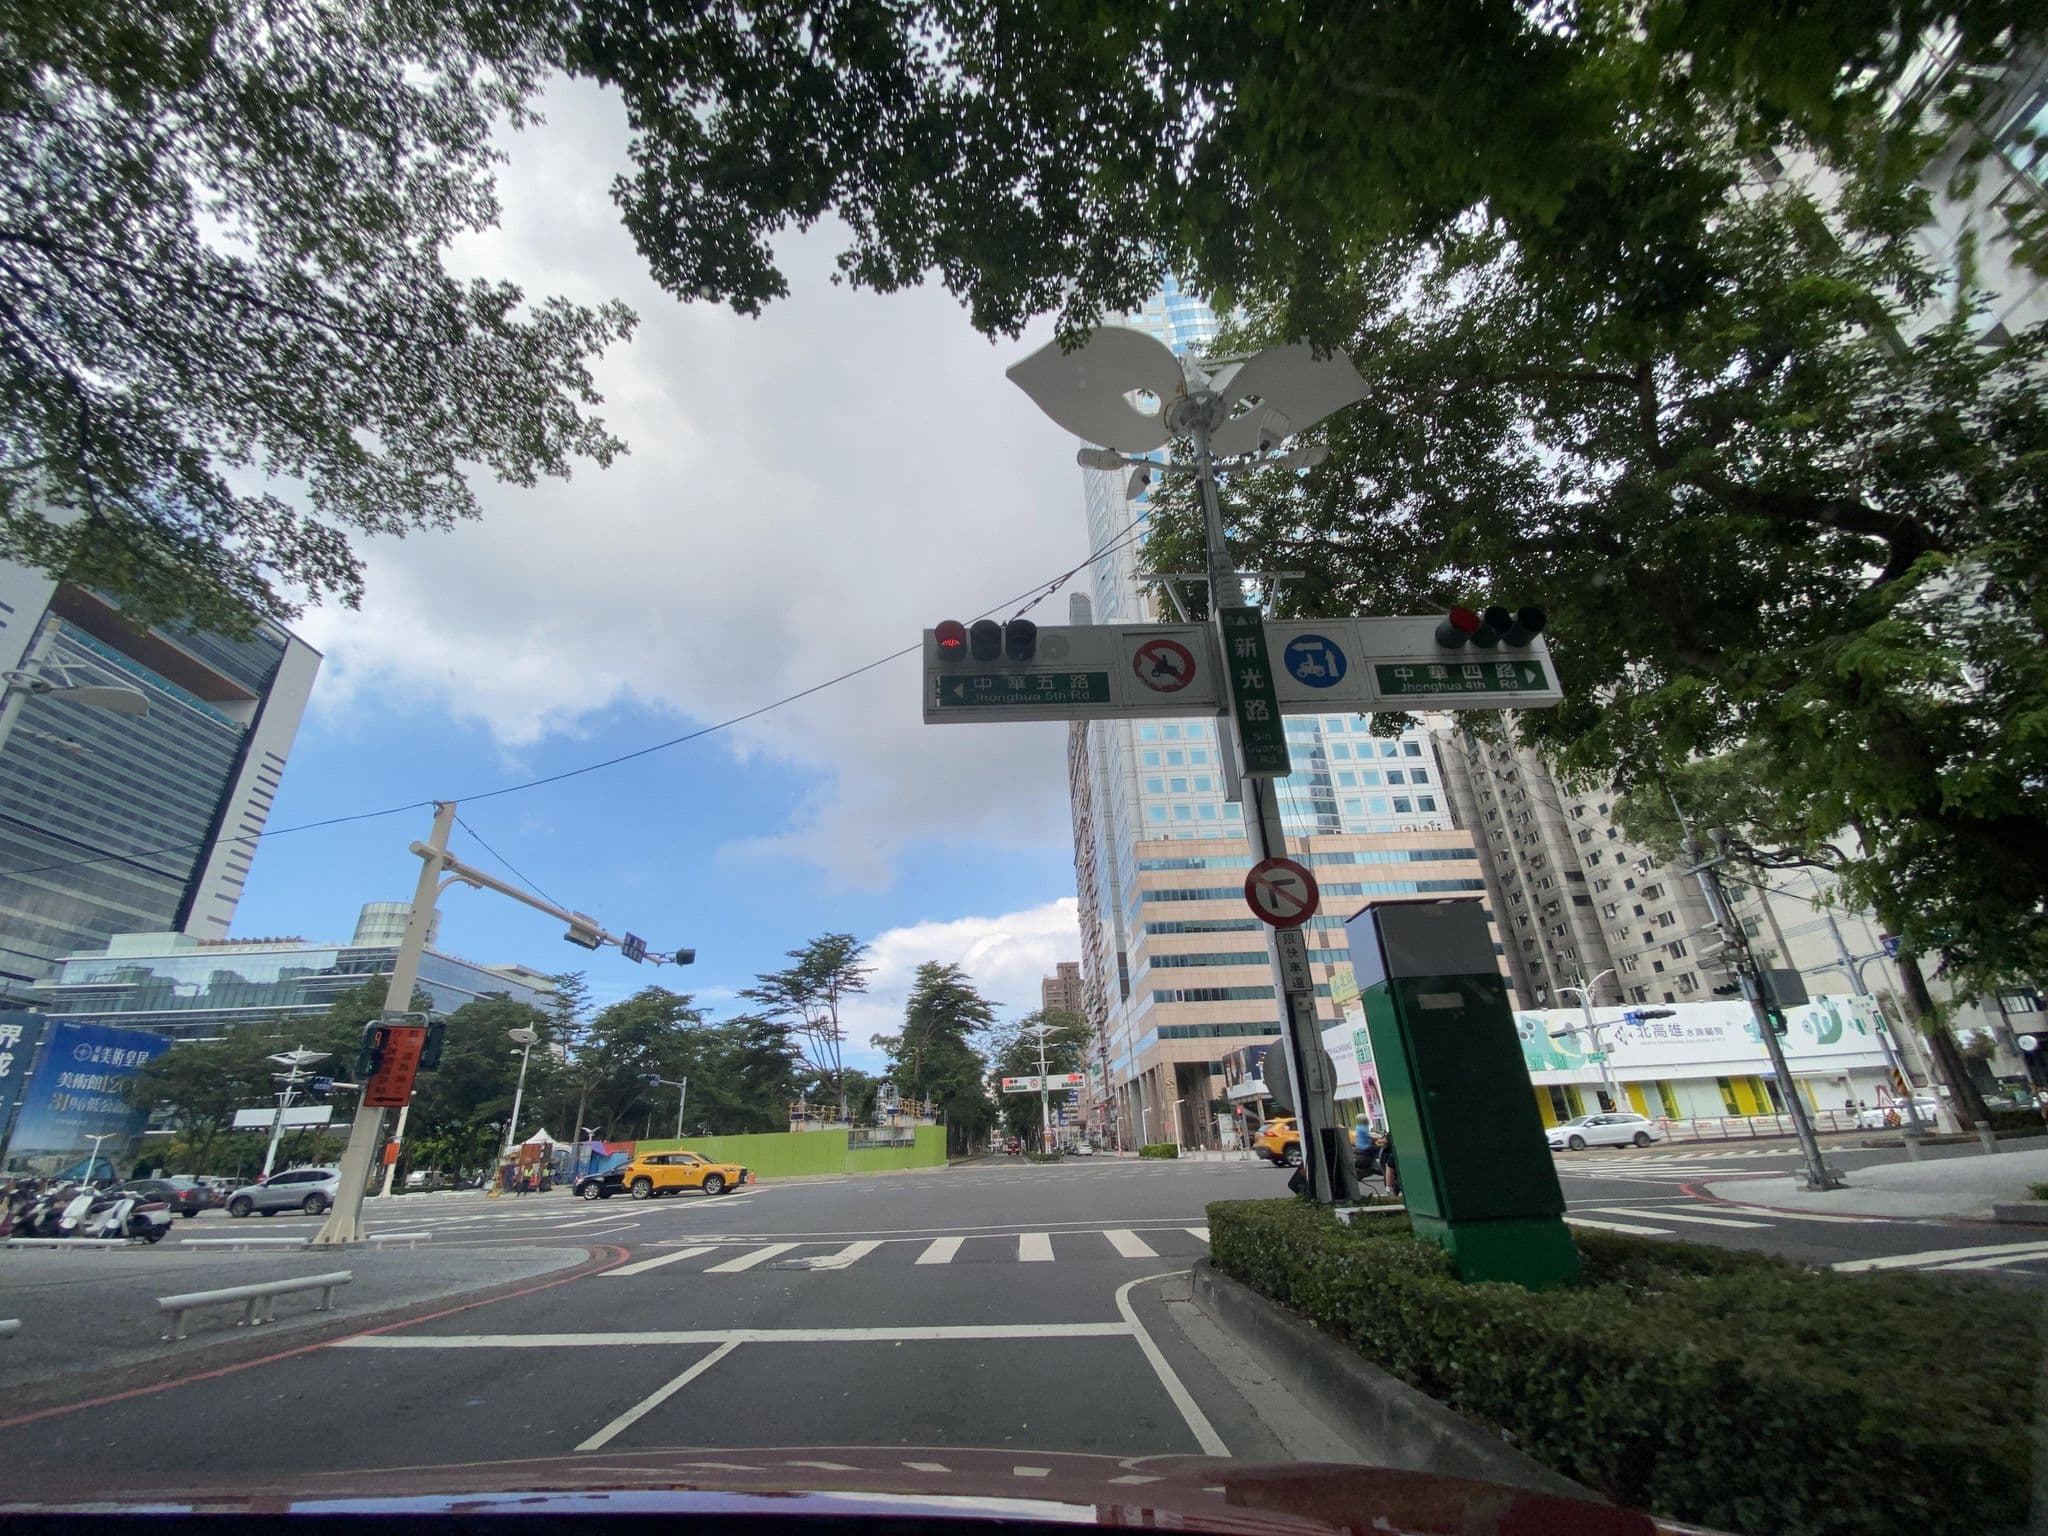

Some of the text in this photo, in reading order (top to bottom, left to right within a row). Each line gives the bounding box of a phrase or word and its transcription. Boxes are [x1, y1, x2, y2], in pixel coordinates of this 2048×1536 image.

[1234, 637, 1269, 720] 新光路
[1394, 663, 1515, 681] 中華四路
[974, 673, 1088, 691] 中華五路
[1401, 681, 1462, 693] Jhonghua
[1465, 680, 1486, 690] 4th
[973, 692, 1041, 704] Jhonghua
[1044, 692, 1066, 701] 5th
[1245, 743, 1283, 754] Guang
[1283, 933, 1305, 988] 限快車道
[1636, 1023, 1683, 1039] 北高雄
